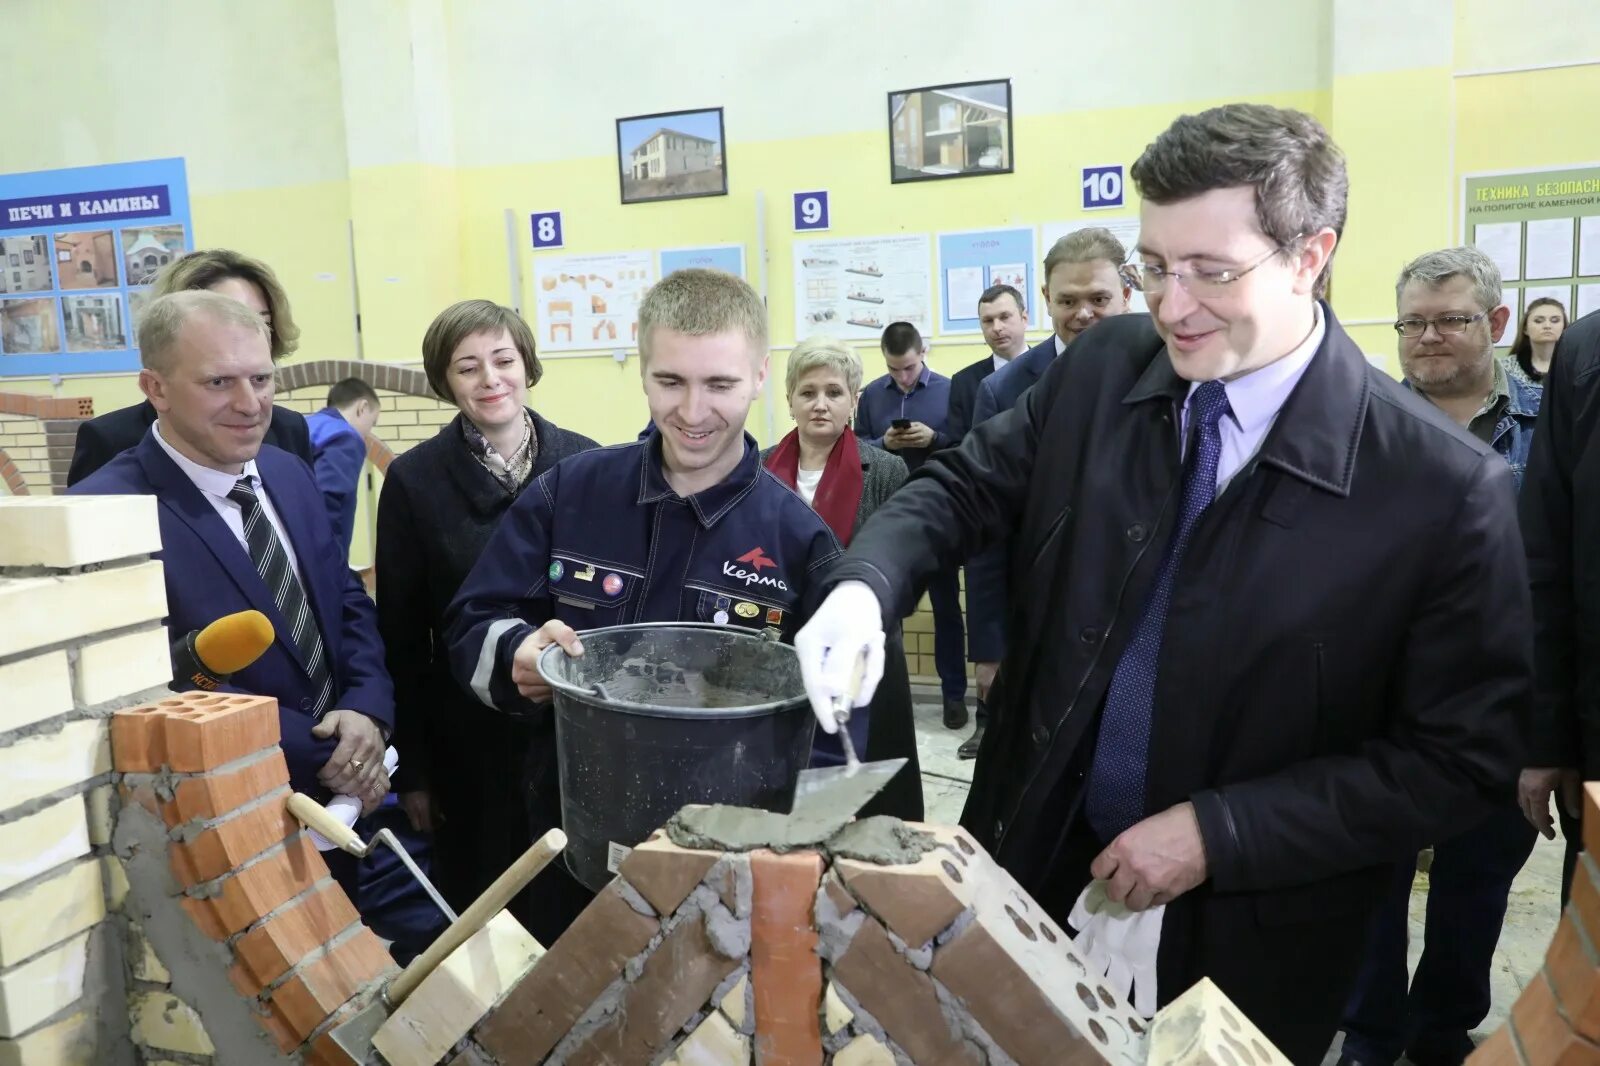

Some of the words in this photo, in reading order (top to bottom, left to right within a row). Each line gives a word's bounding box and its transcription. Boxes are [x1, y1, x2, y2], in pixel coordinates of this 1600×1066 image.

[1083, 172, 1121, 201] 10
[1476, 185, 1529, 201] ТЕХНИКА
[1536, 179, 1600, 196] БЕЗОПАСН
[8, 205, 54, 222] ПЕЧИ
[60, 202, 72, 217] И
[79, 195, 160, 215] КАМИНЫ
[801, 198, 821, 224] 9
[1484, 201, 1536, 212] ПОЛИГОНЕ
[1538, 197, 1594, 208] КАМЕННОЙ
[537, 217, 556, 242] 8
[723, 560, 787, 591] Керма
